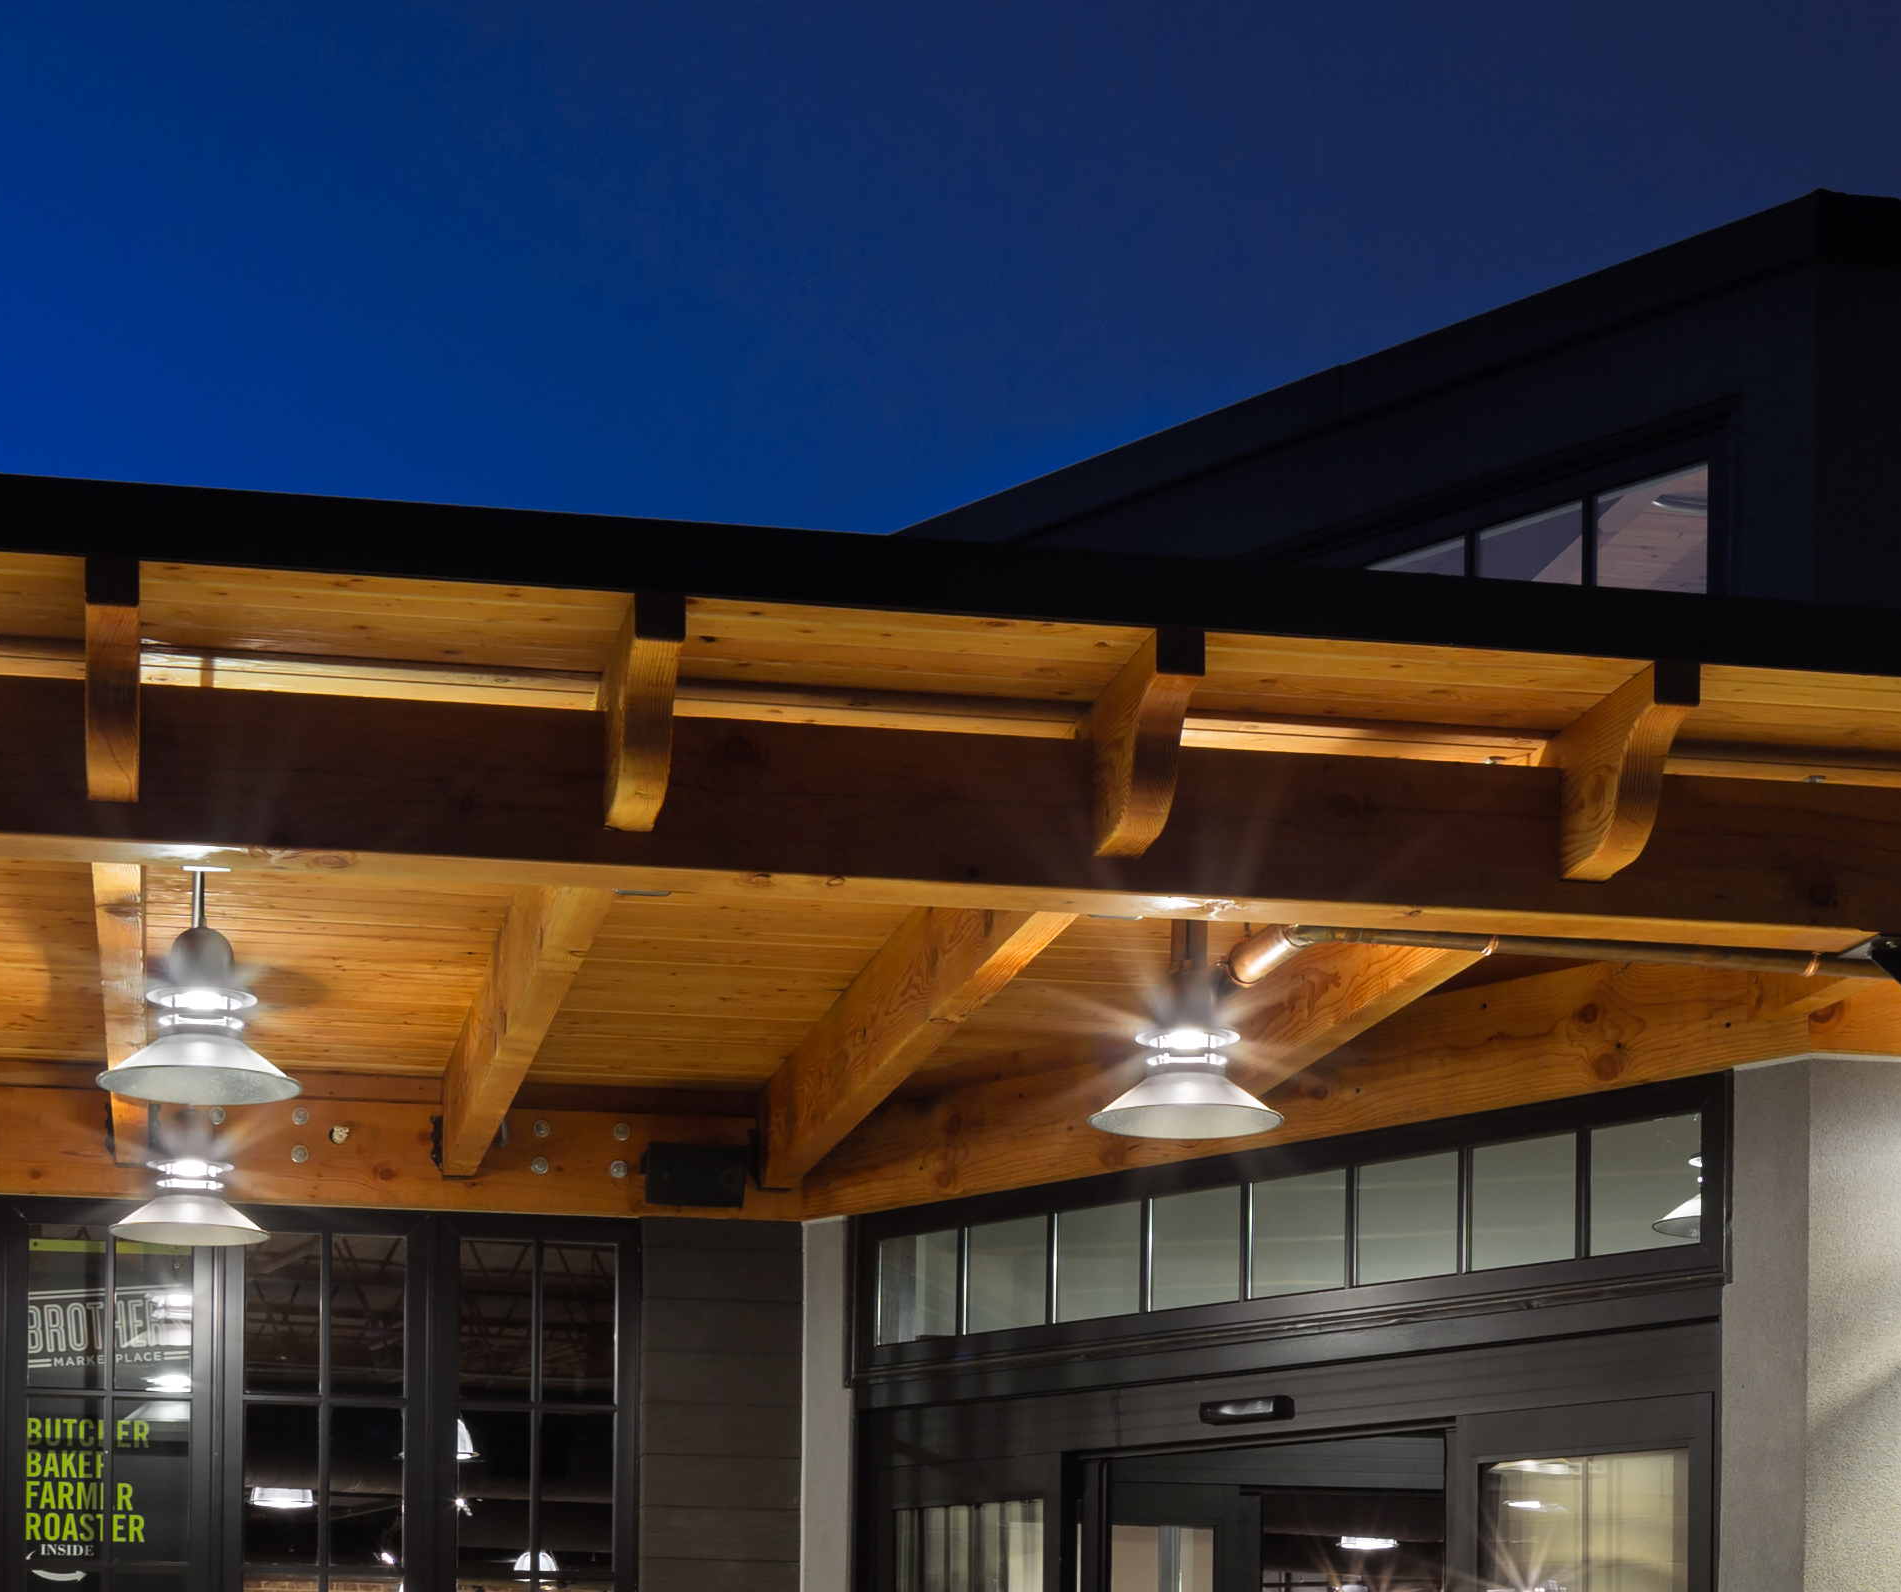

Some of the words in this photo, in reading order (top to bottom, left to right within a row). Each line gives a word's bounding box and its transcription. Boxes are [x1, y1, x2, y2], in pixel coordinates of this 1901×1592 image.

[28, 1299, 188, 1354] BROTHER
[53, 1351, 162, 1367] MARKEPLACE
[25, 1512, 146, 1542] ROASTER
[40, 1544, 95, 1557] INSIDE
